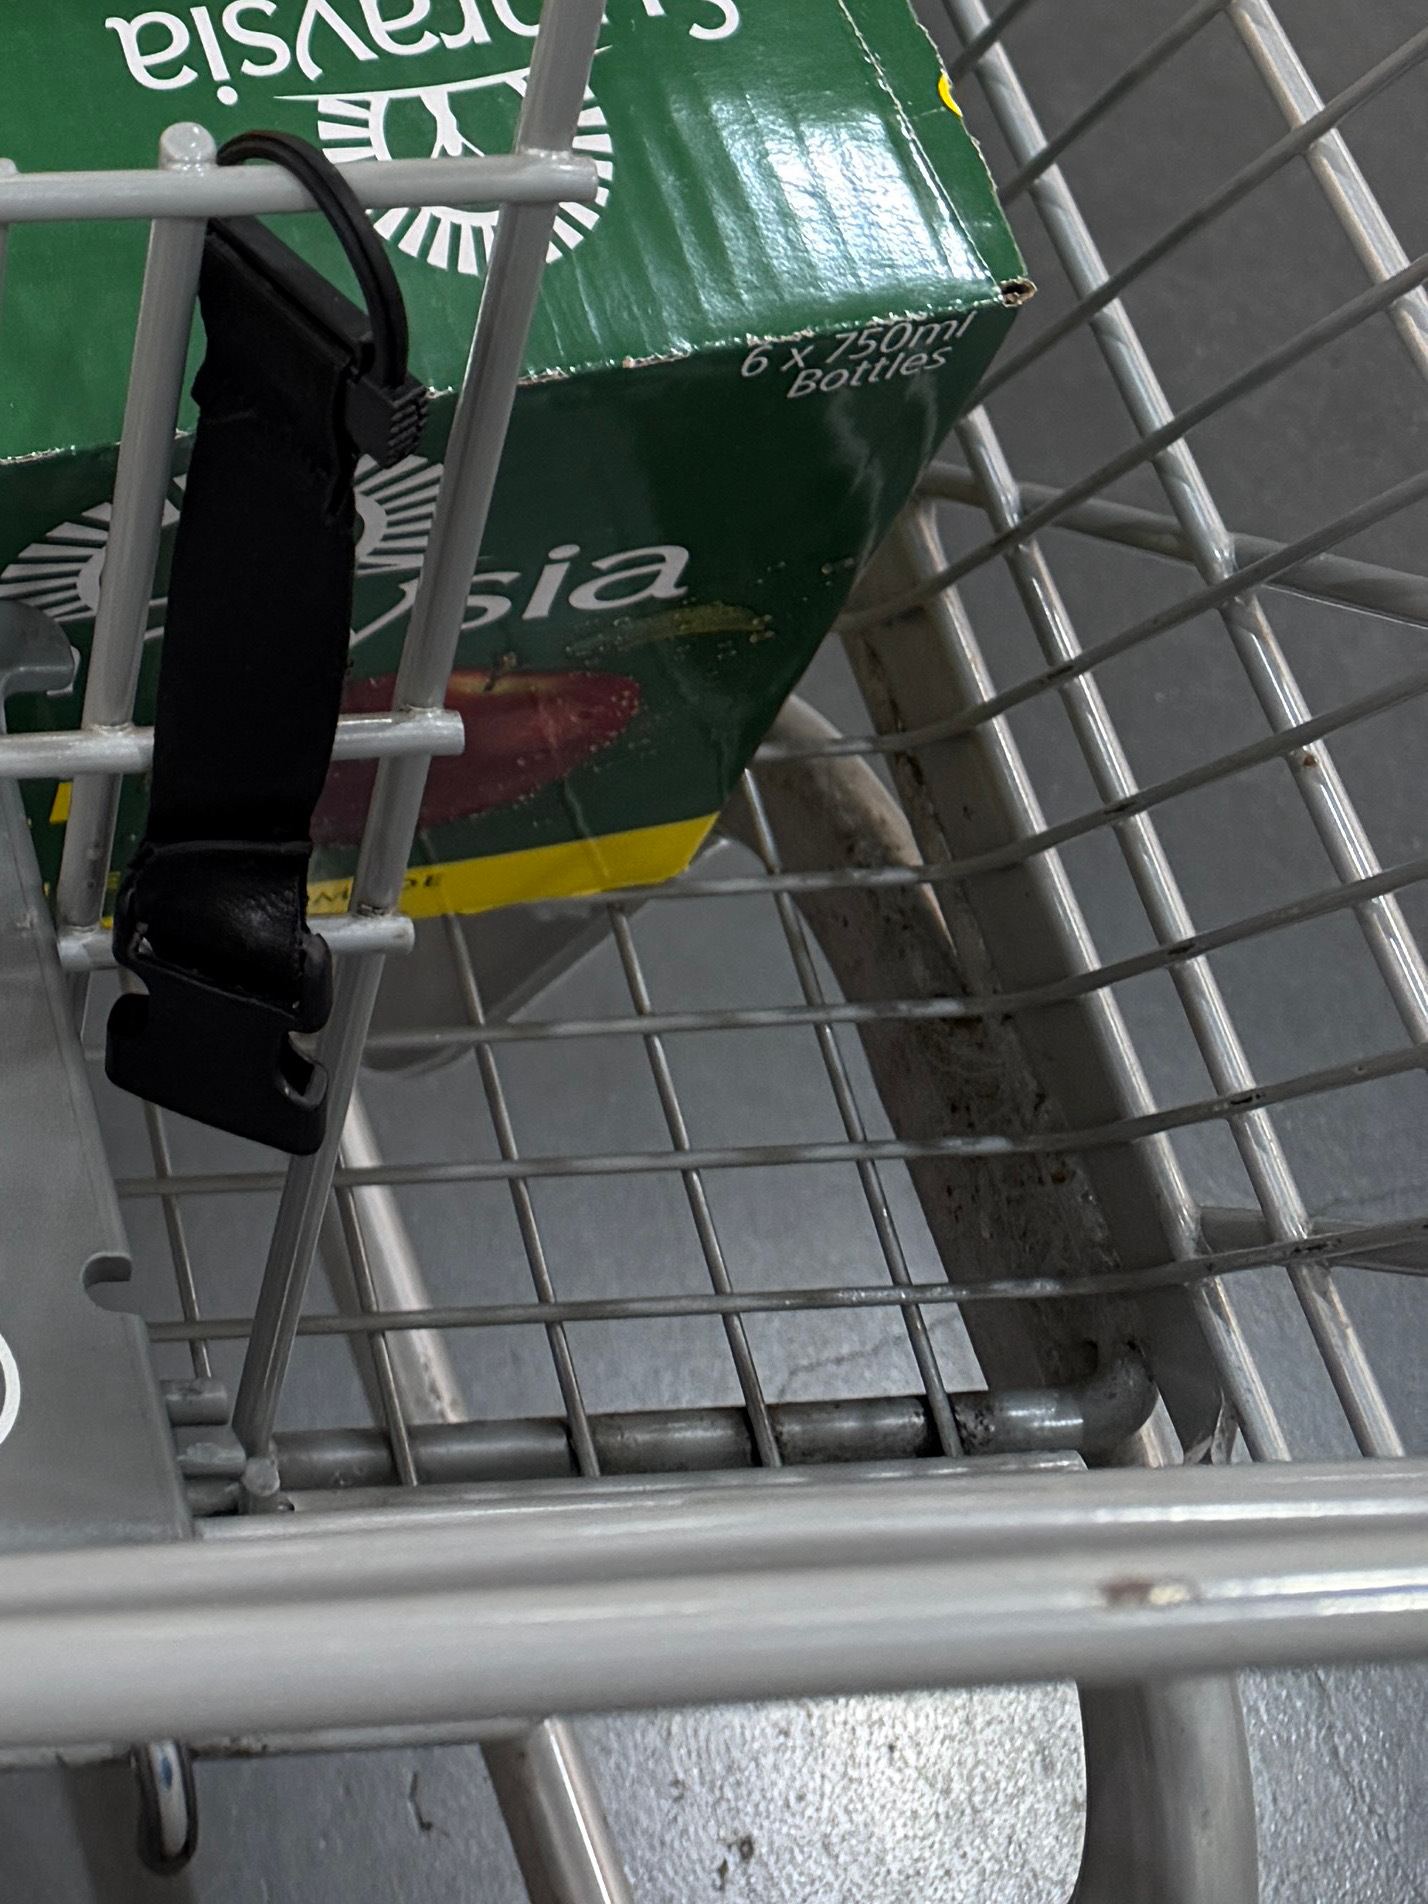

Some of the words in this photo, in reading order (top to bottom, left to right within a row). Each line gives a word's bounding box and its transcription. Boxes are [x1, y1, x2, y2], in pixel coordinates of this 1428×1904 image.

[741, 344, 773, 377] 6
[780, 345, 814, 372] x
[825, 310, 978, 364] 750ml
[787, 346, 952, 399] Bottles
